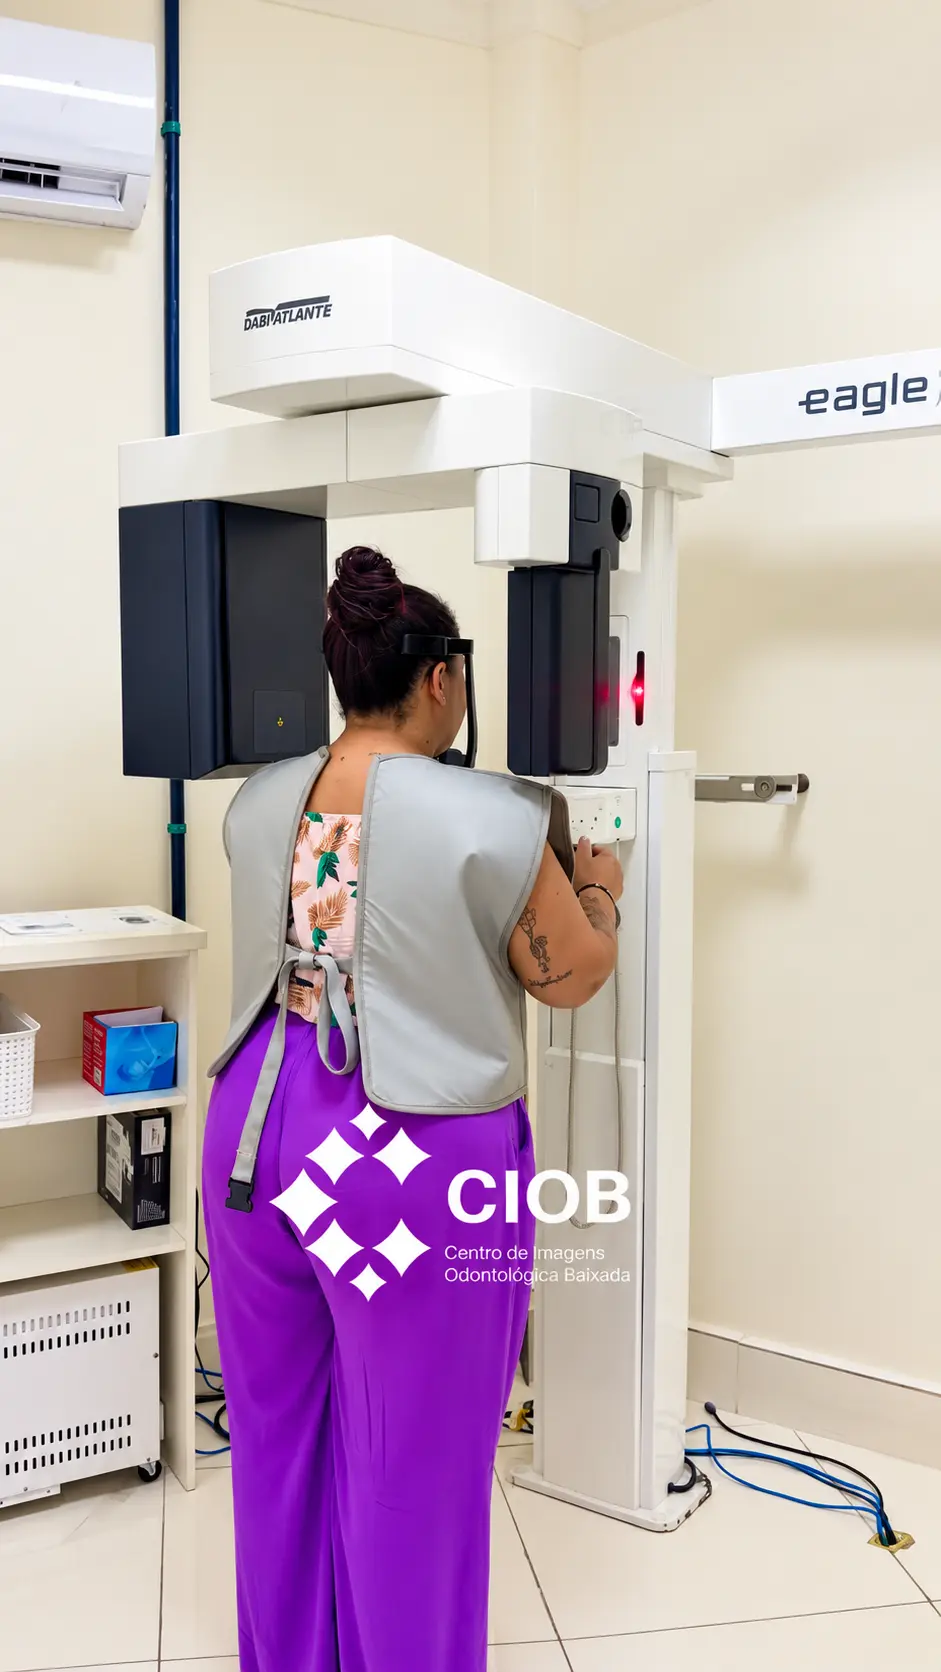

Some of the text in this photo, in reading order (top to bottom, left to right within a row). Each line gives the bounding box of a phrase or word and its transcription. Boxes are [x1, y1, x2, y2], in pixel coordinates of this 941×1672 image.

[243, 304, 332, 331] DABI ATLANTE
[798, 372, 928, 416] eagle
